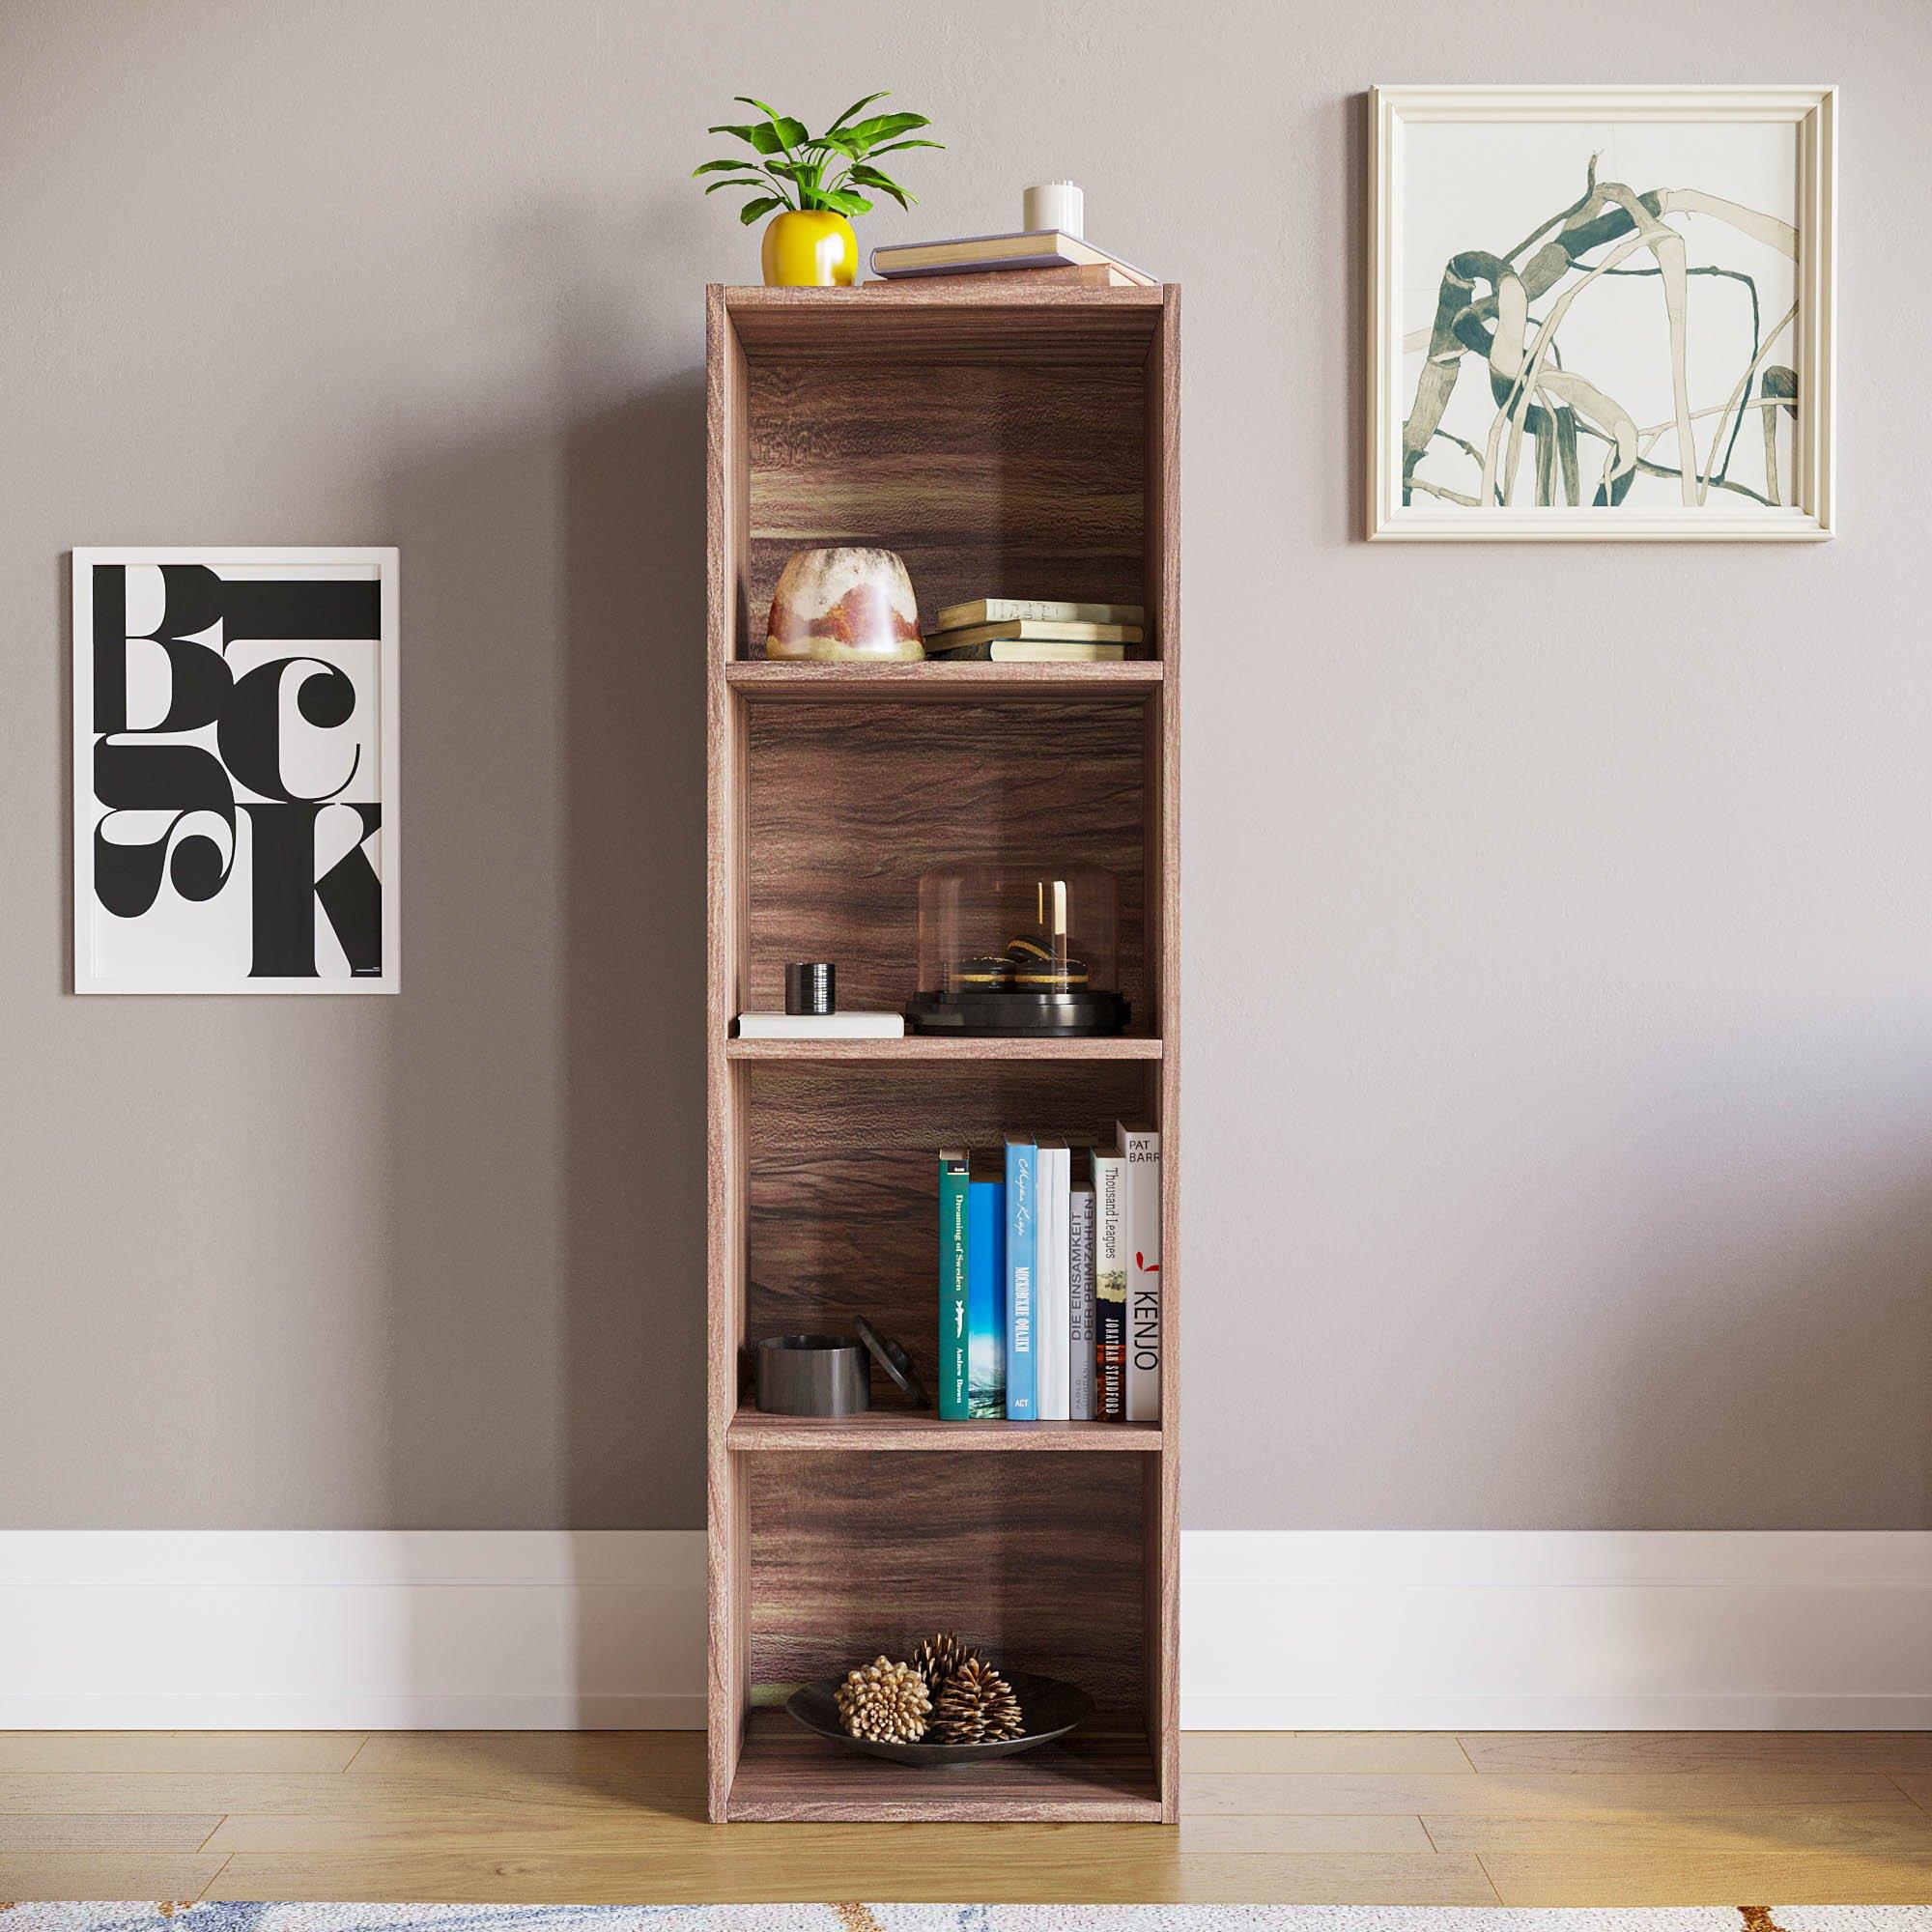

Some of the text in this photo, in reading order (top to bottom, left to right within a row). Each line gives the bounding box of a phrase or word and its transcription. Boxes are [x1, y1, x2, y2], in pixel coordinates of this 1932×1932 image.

[1129, 1140, 1151, 1150] PAT
[954, 1194, 964, 1292] Dreaming of Sweden
[1102, 1167, 1119, 1259] Thousand Leagues
[1071, 1212, 1081, 1341] DIE EINSAMKEIT
[1084, 1199, 1094, 1341] DER PRIMZAHLEN
[955, 1347, 964, 1404] Andrew Brown
[1105, 1318, 1119, 1413] JONATHAN STANDFORD
[1134, 1292, 1158, 1370] KENJO
